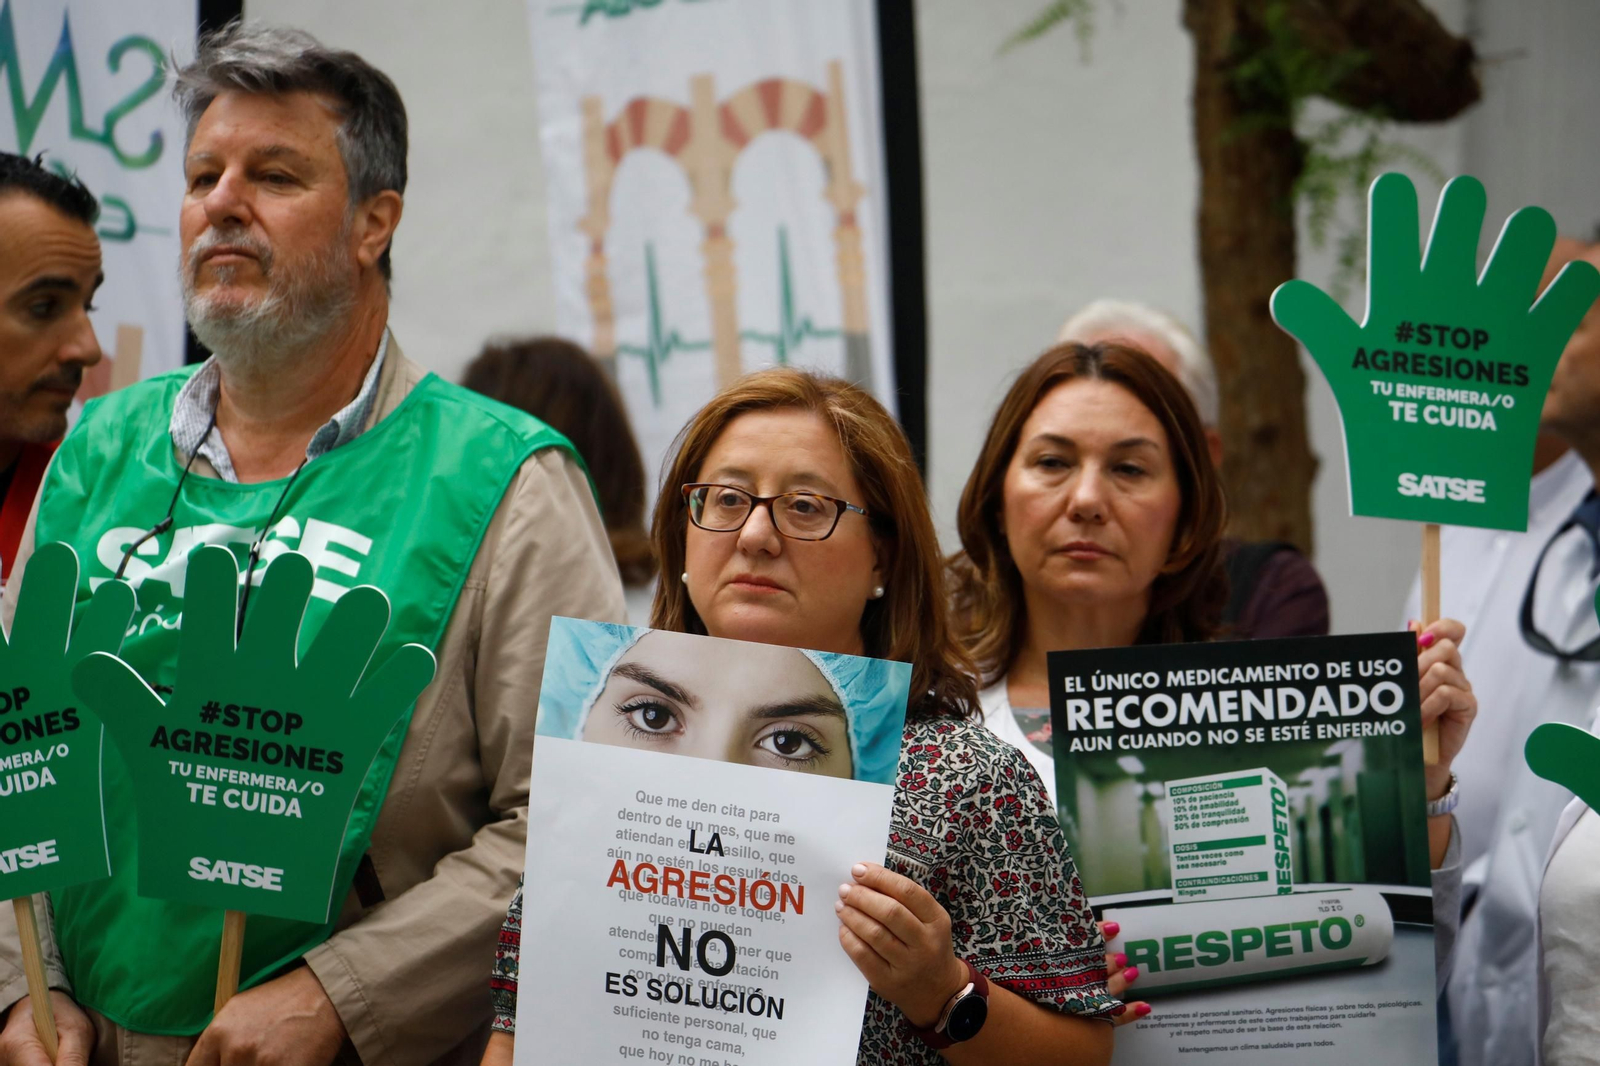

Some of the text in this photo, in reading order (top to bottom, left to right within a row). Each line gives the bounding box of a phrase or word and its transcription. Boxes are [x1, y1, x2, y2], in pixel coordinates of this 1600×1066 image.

[1395, 321, 1489, 351] #STOP
[1352, 347, 1529, 386] AGRESIONES
[1370, 380, 1514, 408] TU ENFERMERA/O
[1389, 401, 1497, 431] TE CUIDA
[1397, 472, 1486, 503] SATSE
[1064, 658, 1403, 693] EL ÚNICO MEDICAMENTO DE USO
[199, 700, 303, 736] #STOP
[1066, 681, 1404, 731] RECOMENDADO
[150, 725, 344, 775] AGRESIONES
[1069, 719, 1406, 752] AUN CUANDO NO SE ESTÉ ENFERMO
[168, 760, 324, 796] TU ENFERMERA/O
[1172, 783, 1223, 795] COMPOSICIÓN
[186, 782, 302, 819] TE CUIDA
[636, 790, 780, 823] Que me den cita para
[1199, 791, 1235, 802] paciencia
[1199, 799, 1239, 810] amabilidad
[617, 808, 795, 845] dentro de un mes, que me
[1191, 812, 1199, 820] de
[1201, 807, 1246, 819] tranquilidad
[1202, 816, 1249, 828] comprensión
[615, 828, 674, 847] atiendan
[769, 852, 795, 865] que
[689, 829, 725, 857] LA
[1175, 844, 1198, 852] DOSIS
[187, 856, 284, 892] SATSE
[607, 846, 631, 860] aún
[636, 852, 653, 864] no
[657, 855, 694, 870] estén
[699, 859, 719, 873] los
[1190, 859, 1227, 868] necesario
[606, 859, 804, 915] AGRESIÓN
[1177, 874, 1259, 887] CONTRAINDICACIONES
[1178, 888, 1206, 897] Ninguna
[618, 889, 785, 924] que todavía no te toque,
[648, 913, 752, 937] que no puedan
[656, 923, 736, 977] NO
[765, 949, 792, 962] que
[627, 968, 653, 981] con
[657, 971, 693, 986] otros
[605, 972, 638, 997] ES
[646, 978, 784, 1020] SOLUCIÓN
[612, 1004, 777, 1040] suficiente personal, que
[1150, 1021, 1189, 1029] enfermeras
[1197, 1018, 1236, 1026] enfermeros
[1265, 1015, 1288, 1023] centro
[1289, 1013, 1328, 1022] trabajamos
[1347, 1011, 1376, 1019] cuidarle
[1153, 1013, 1190, 1021] agresiones
[1200, 1009, 1230, 1018] personal
[1266, 1007, 1304, 1016] Agresiones
[642, 1028, 745, 1057] no tenga cama,
[1184, 1028, 1210, 1036] respeto
[1261, 1041, 1294, 1050] saludable
[619, 1045, 644, 1058] que
[649, 1047, 674, 1065] hoy
[678, 1054, 695, 1066] no
